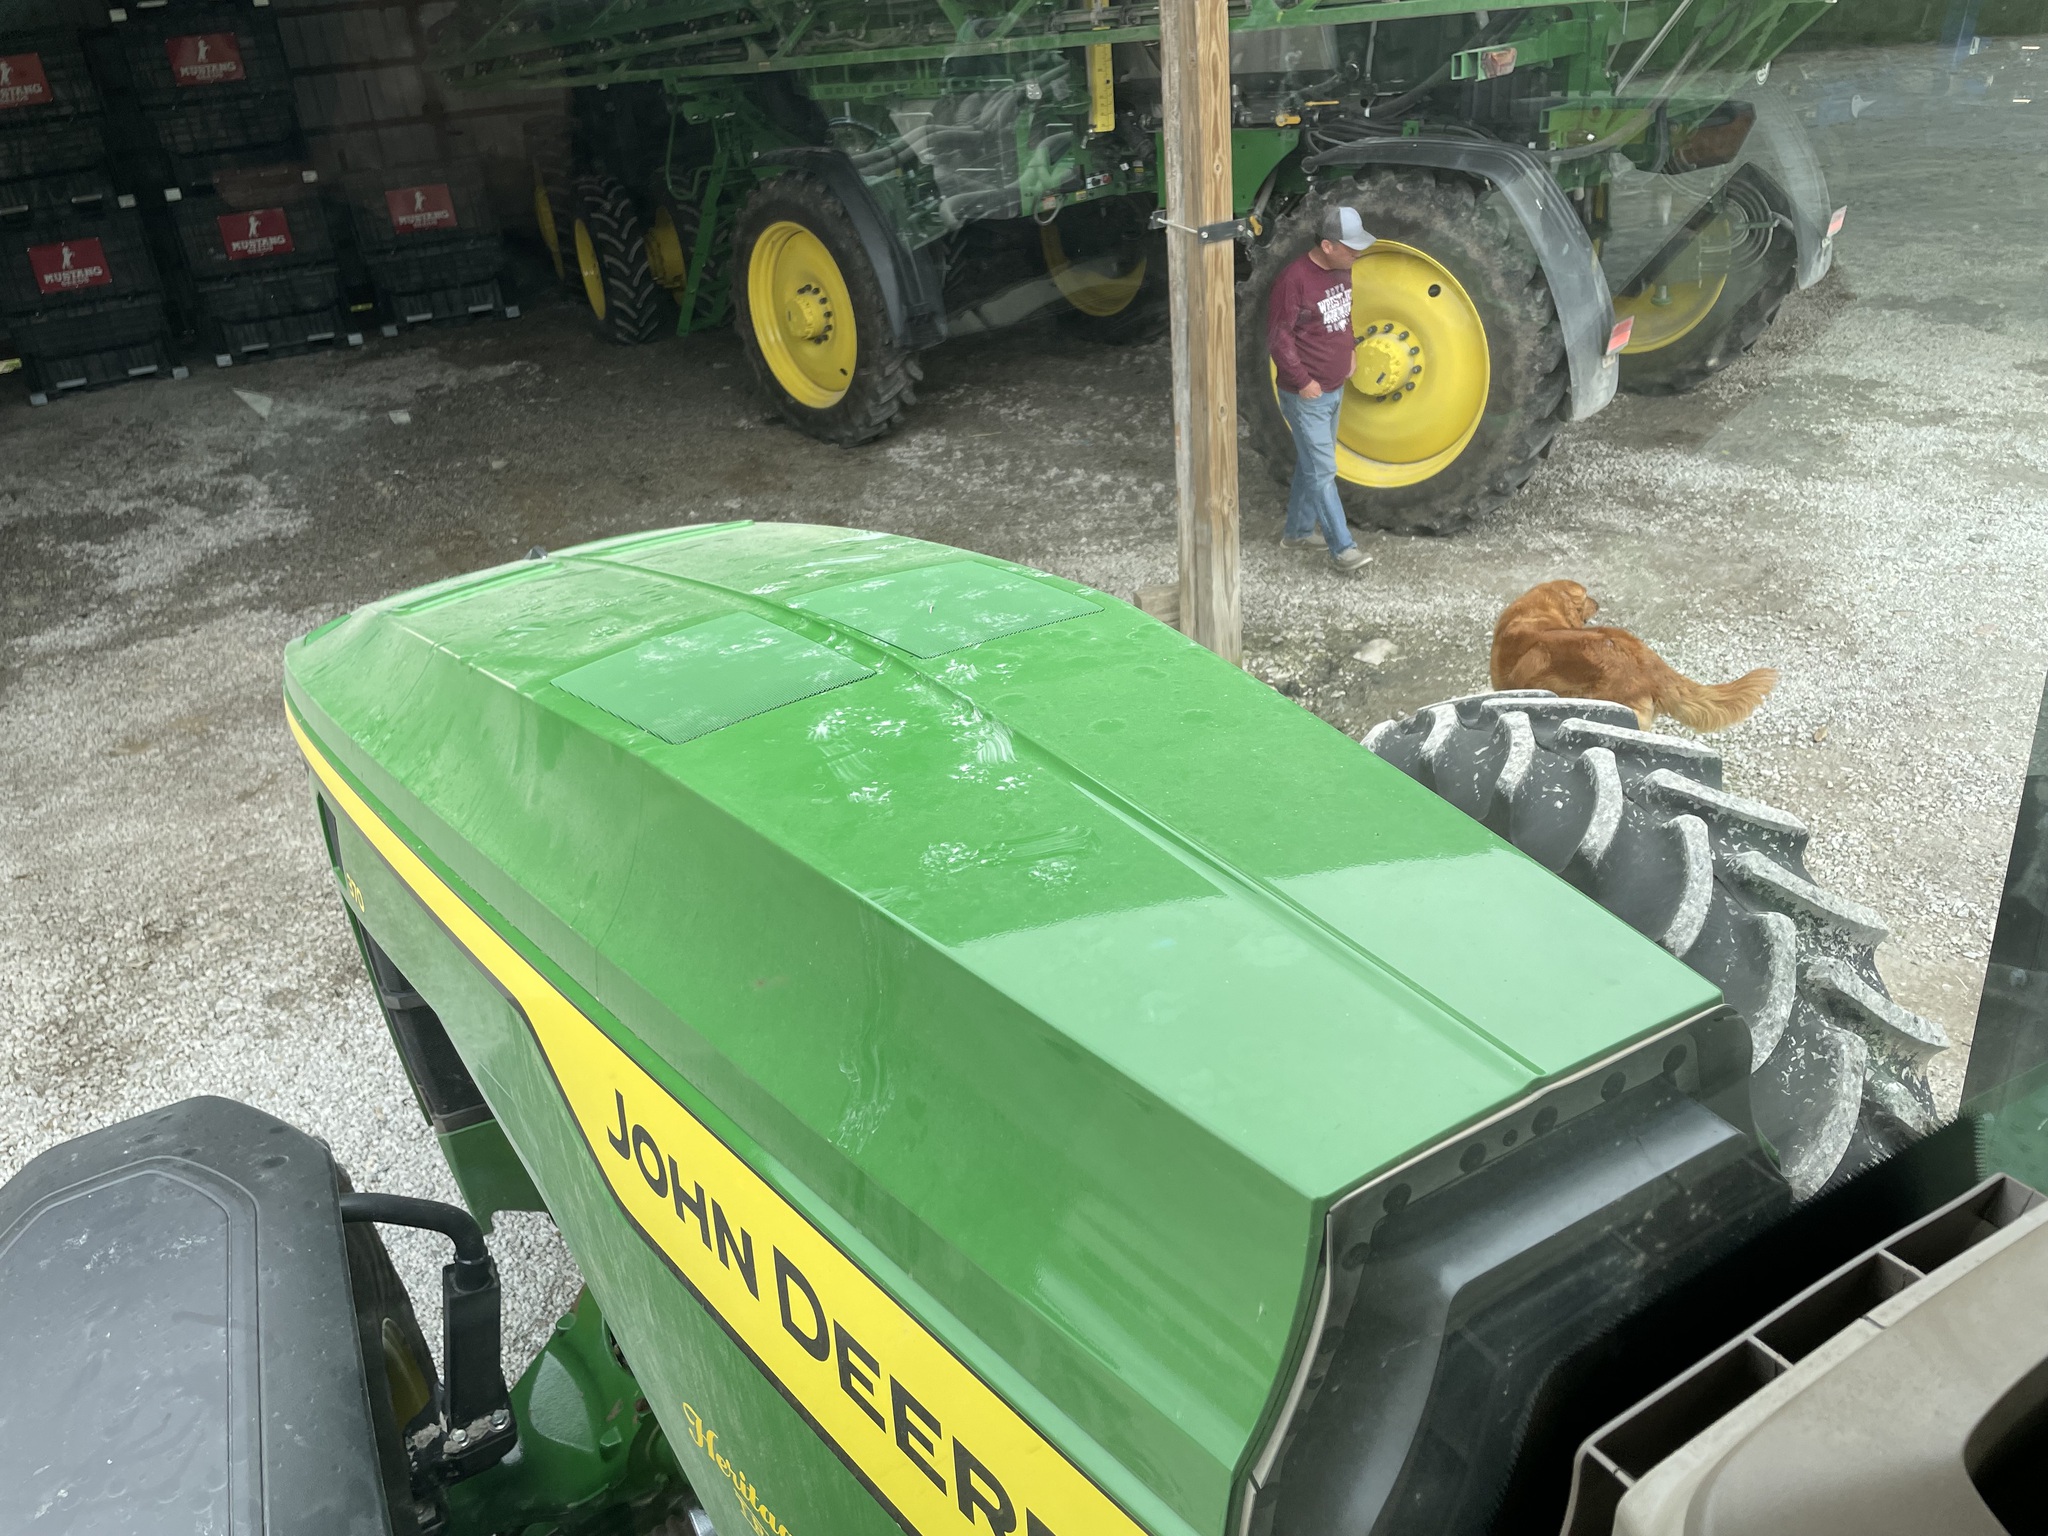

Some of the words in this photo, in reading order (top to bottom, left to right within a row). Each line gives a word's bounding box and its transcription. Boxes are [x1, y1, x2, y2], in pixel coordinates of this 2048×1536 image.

[231, 234, 287, 252] MUSTANG
[43, 265, 103, 285] MUSTANG
[606, 1088, 760, 1302] JOHN
